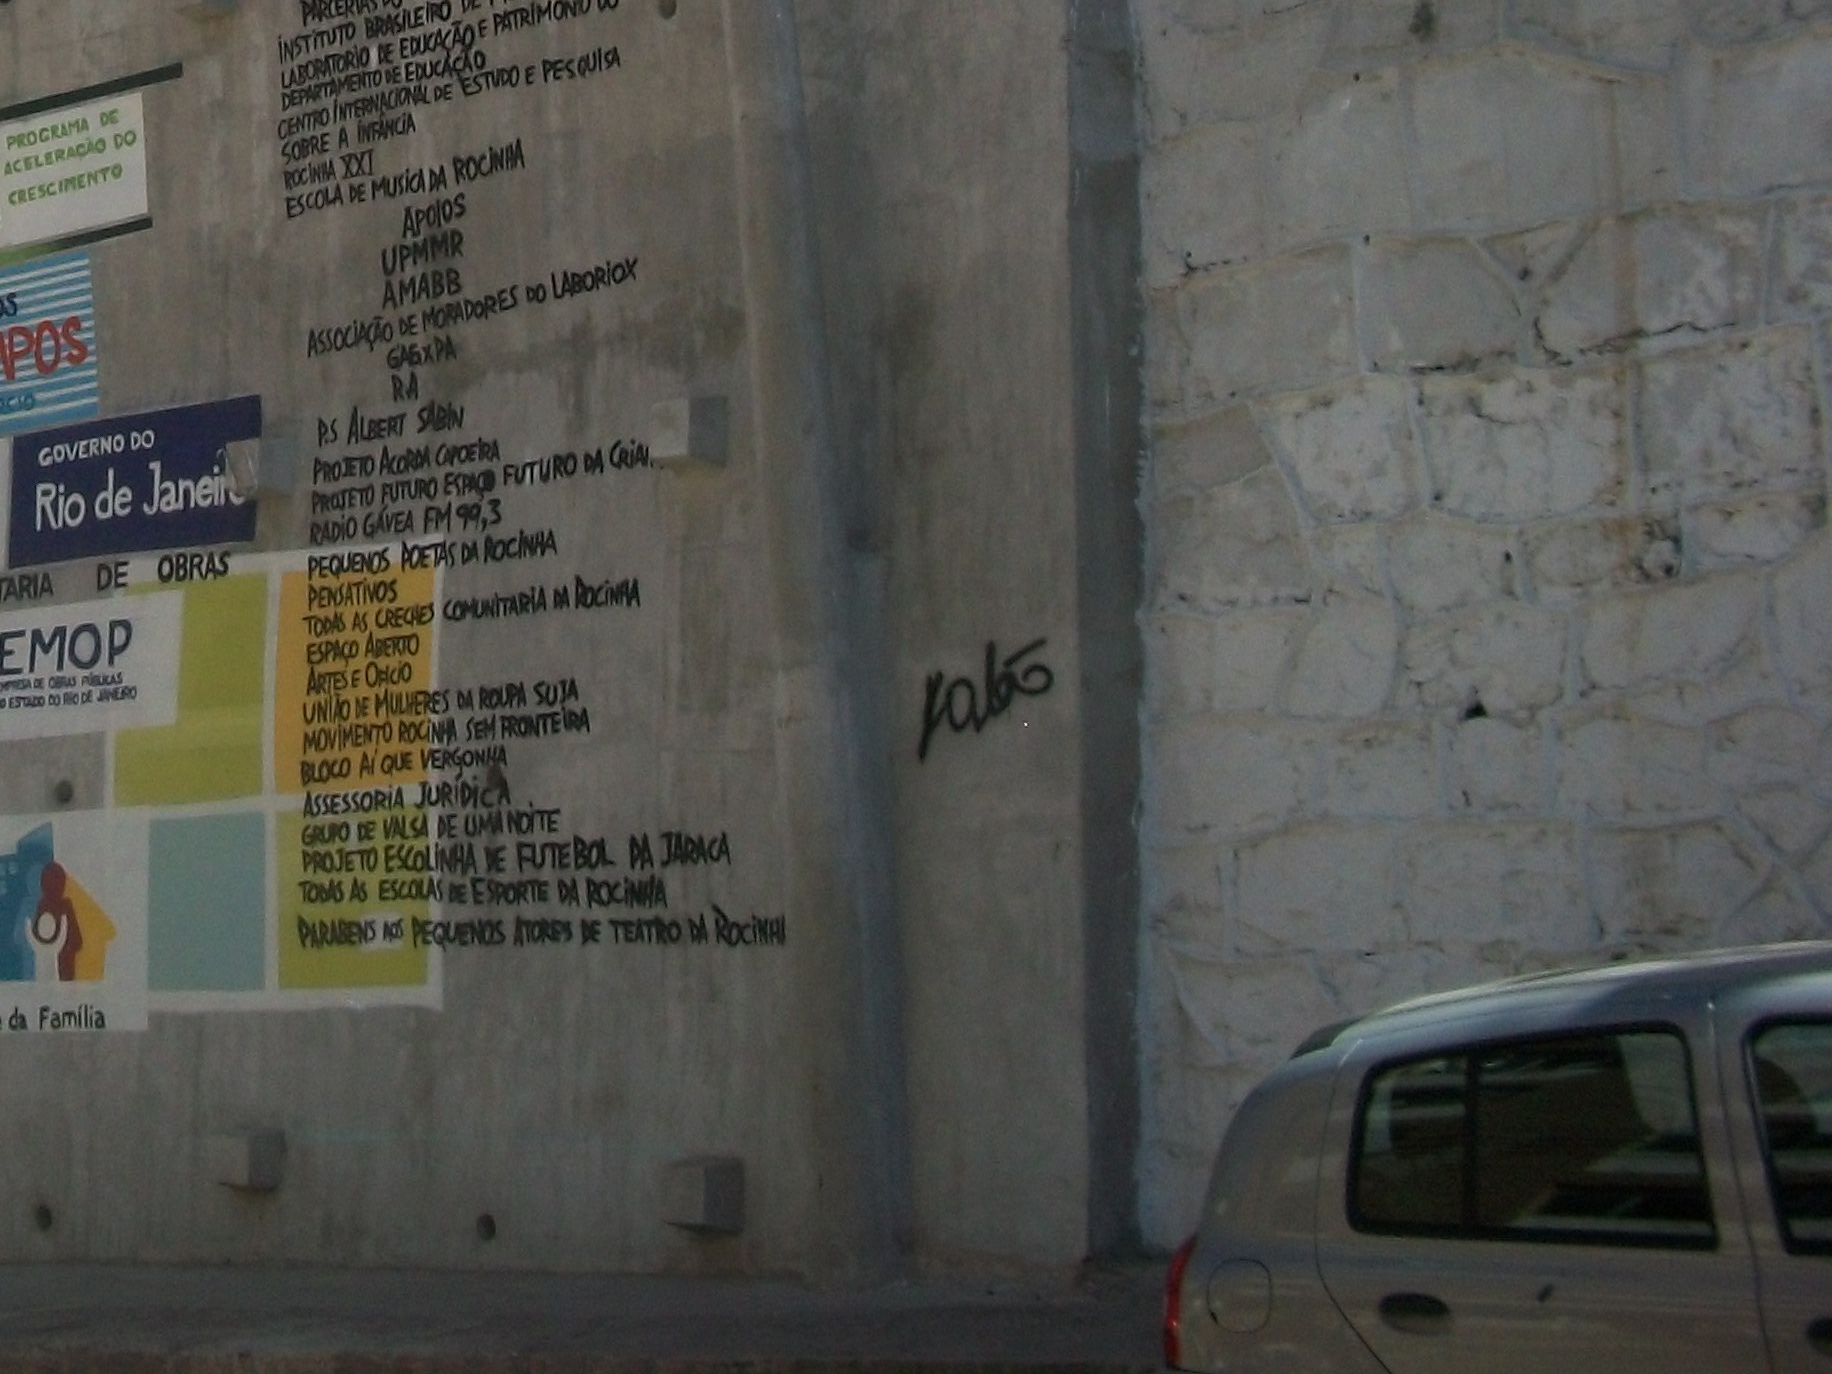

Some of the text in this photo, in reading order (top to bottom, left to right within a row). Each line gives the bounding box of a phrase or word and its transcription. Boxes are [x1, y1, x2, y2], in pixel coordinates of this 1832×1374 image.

[278, 21, 356, 65] INSTITUTO
[278, 46, 621, 140] CENTRO INTERNACIONAL DE ESTUDO PESQUISA
[281, 68, 382, 112] DEPARTAMENTO
[6, 107, 121, 150] PROGRAMA DE
[281, 132, 330, 165] SOBRE
[3, 129, 137, 176] ACELERAÇÃO DO
[283, 148, 374, 191] ROCINHA XXI
[8, 163, 124, 206] CRESCIMENTO
[285, 184, 344, 220] ESCOLA
[348, 183, 367, 203] DE
[452, 136, 526, 186] ROCINHA
[402, 192, 467, 239] APOIOS
[380, 228, 465, 276] UPMMR
[382, 267, 462, 310] AMABB
[307, 314, 394, 359] ASSOCIAÇÃO
[399, 313, 418, 337] DE
[422, 283, 518, 332] MORADORES
[525, 282, 547, 304] DO
[347, 399, 464, 445] ALBERT SABIN
[37, 429, 155, 468] GOVERNO DO
[313, 455, 375, 486] PROJETO
[379, 444, 431, 476] ACORDA
[34, 482, 86, 533] Rio
[94, 467, 133, 521] de
[311, 447, 604, 515] PROJETO FUTURO FUTURO DA
[309, 514, 358, 545] RADIO
[424, 501, 452, 534] FM
[456, 498, 502, 532] 99,3
[96, 561, 129, 592] DE
[157, 550, 230, 583] OBRAS
[307, 528, 558, 581] PEQUENOS POETAS DA ROCINHA
[303, 574, 641, 638] TODAS AS CRECHES DA ROCINHA
[308, 577, 398, 612] PENSATIVOS
[306, 631, 420, 668] ESPAÇO ABERTO
[306, 666, 348, 697] ARTES
[375, 687, 450, 718] MULHERES
[456, 687, 474, 711] DA
[479, 680, 527, 709] ROUPA
[533, 675, 579, 708] SUJA
[303, 705, 590, 755] MOVIMENTO ROCINHA SEM FRONTEIRA
[300, 744, 508, 787] BLOCO QUE VERGONHA
[302, 801, 561, 846] GRUPO DE VALSA DE UMA NOITE
[303, 786, 404, 818] ASSESSORIA
[302, 832, 653, 877] PROJETO ESCOLINHA FUTEBOL DA
[299, 874, 667, 909] TODAS ESCOLAS ESPORTE DA ROCINHA
[411, 916, 506, 952] PEQUENOS
[607, 916, 682, 945] TEATRO
[8, 1007, 28, 1030] da
[38, 1003, 107, 1030] Família
